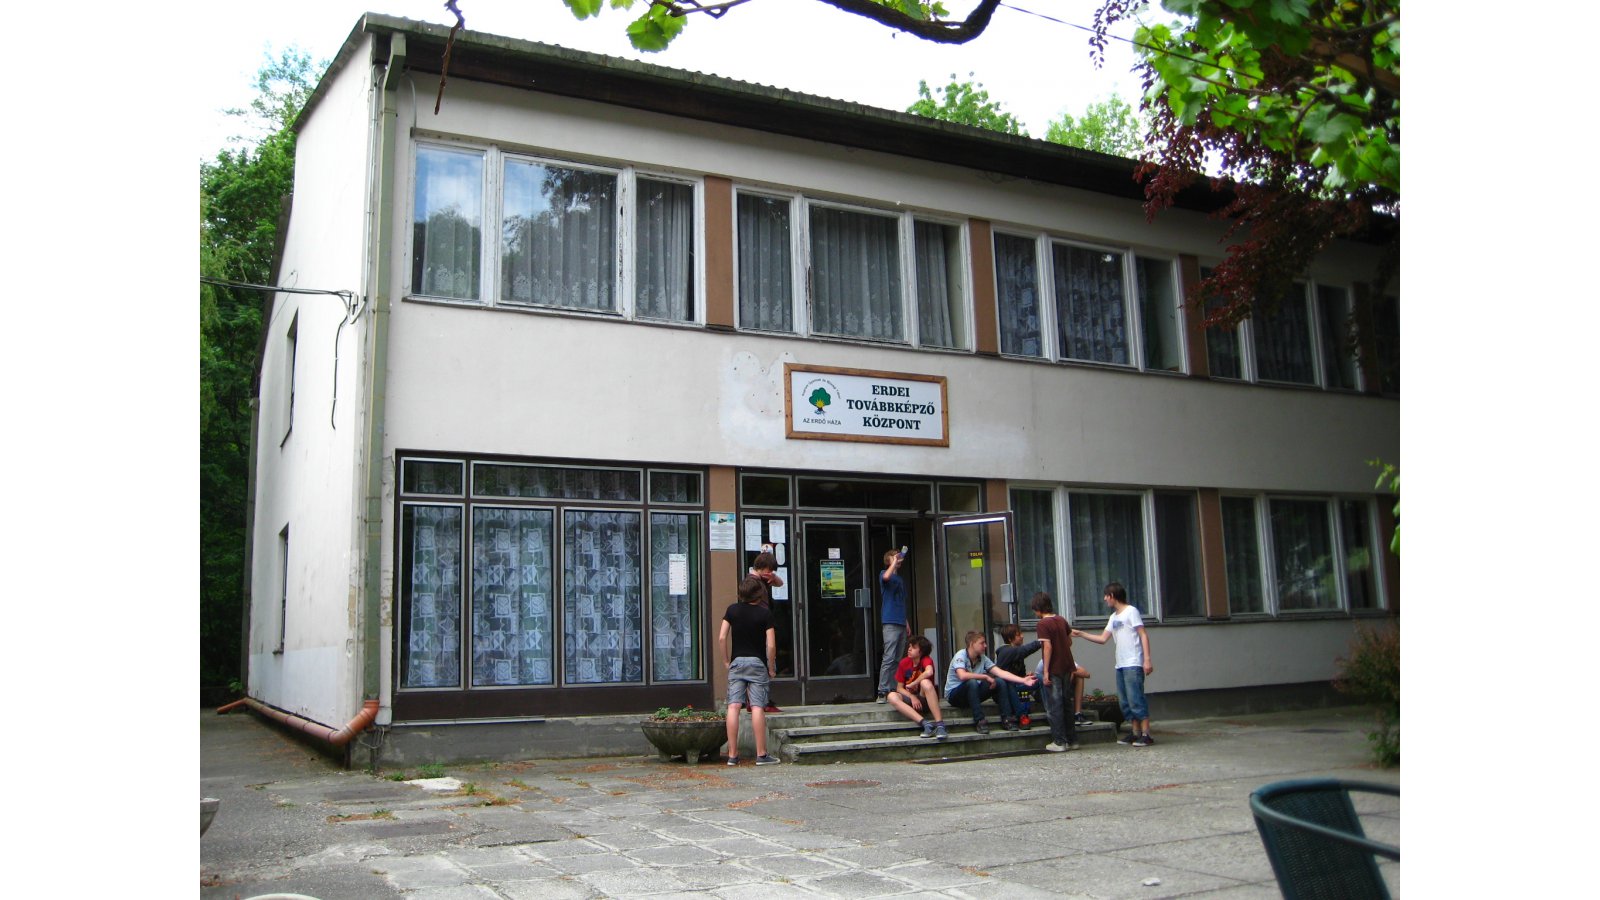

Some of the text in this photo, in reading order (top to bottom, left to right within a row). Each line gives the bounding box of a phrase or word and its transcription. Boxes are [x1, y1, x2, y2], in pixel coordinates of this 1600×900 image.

[872, 385, 910, 397] ERDEI
[846, 398, 935, 415] TOVÁBBKÉPZŐ
[863, 415, 921, 430] KÖZPONT
